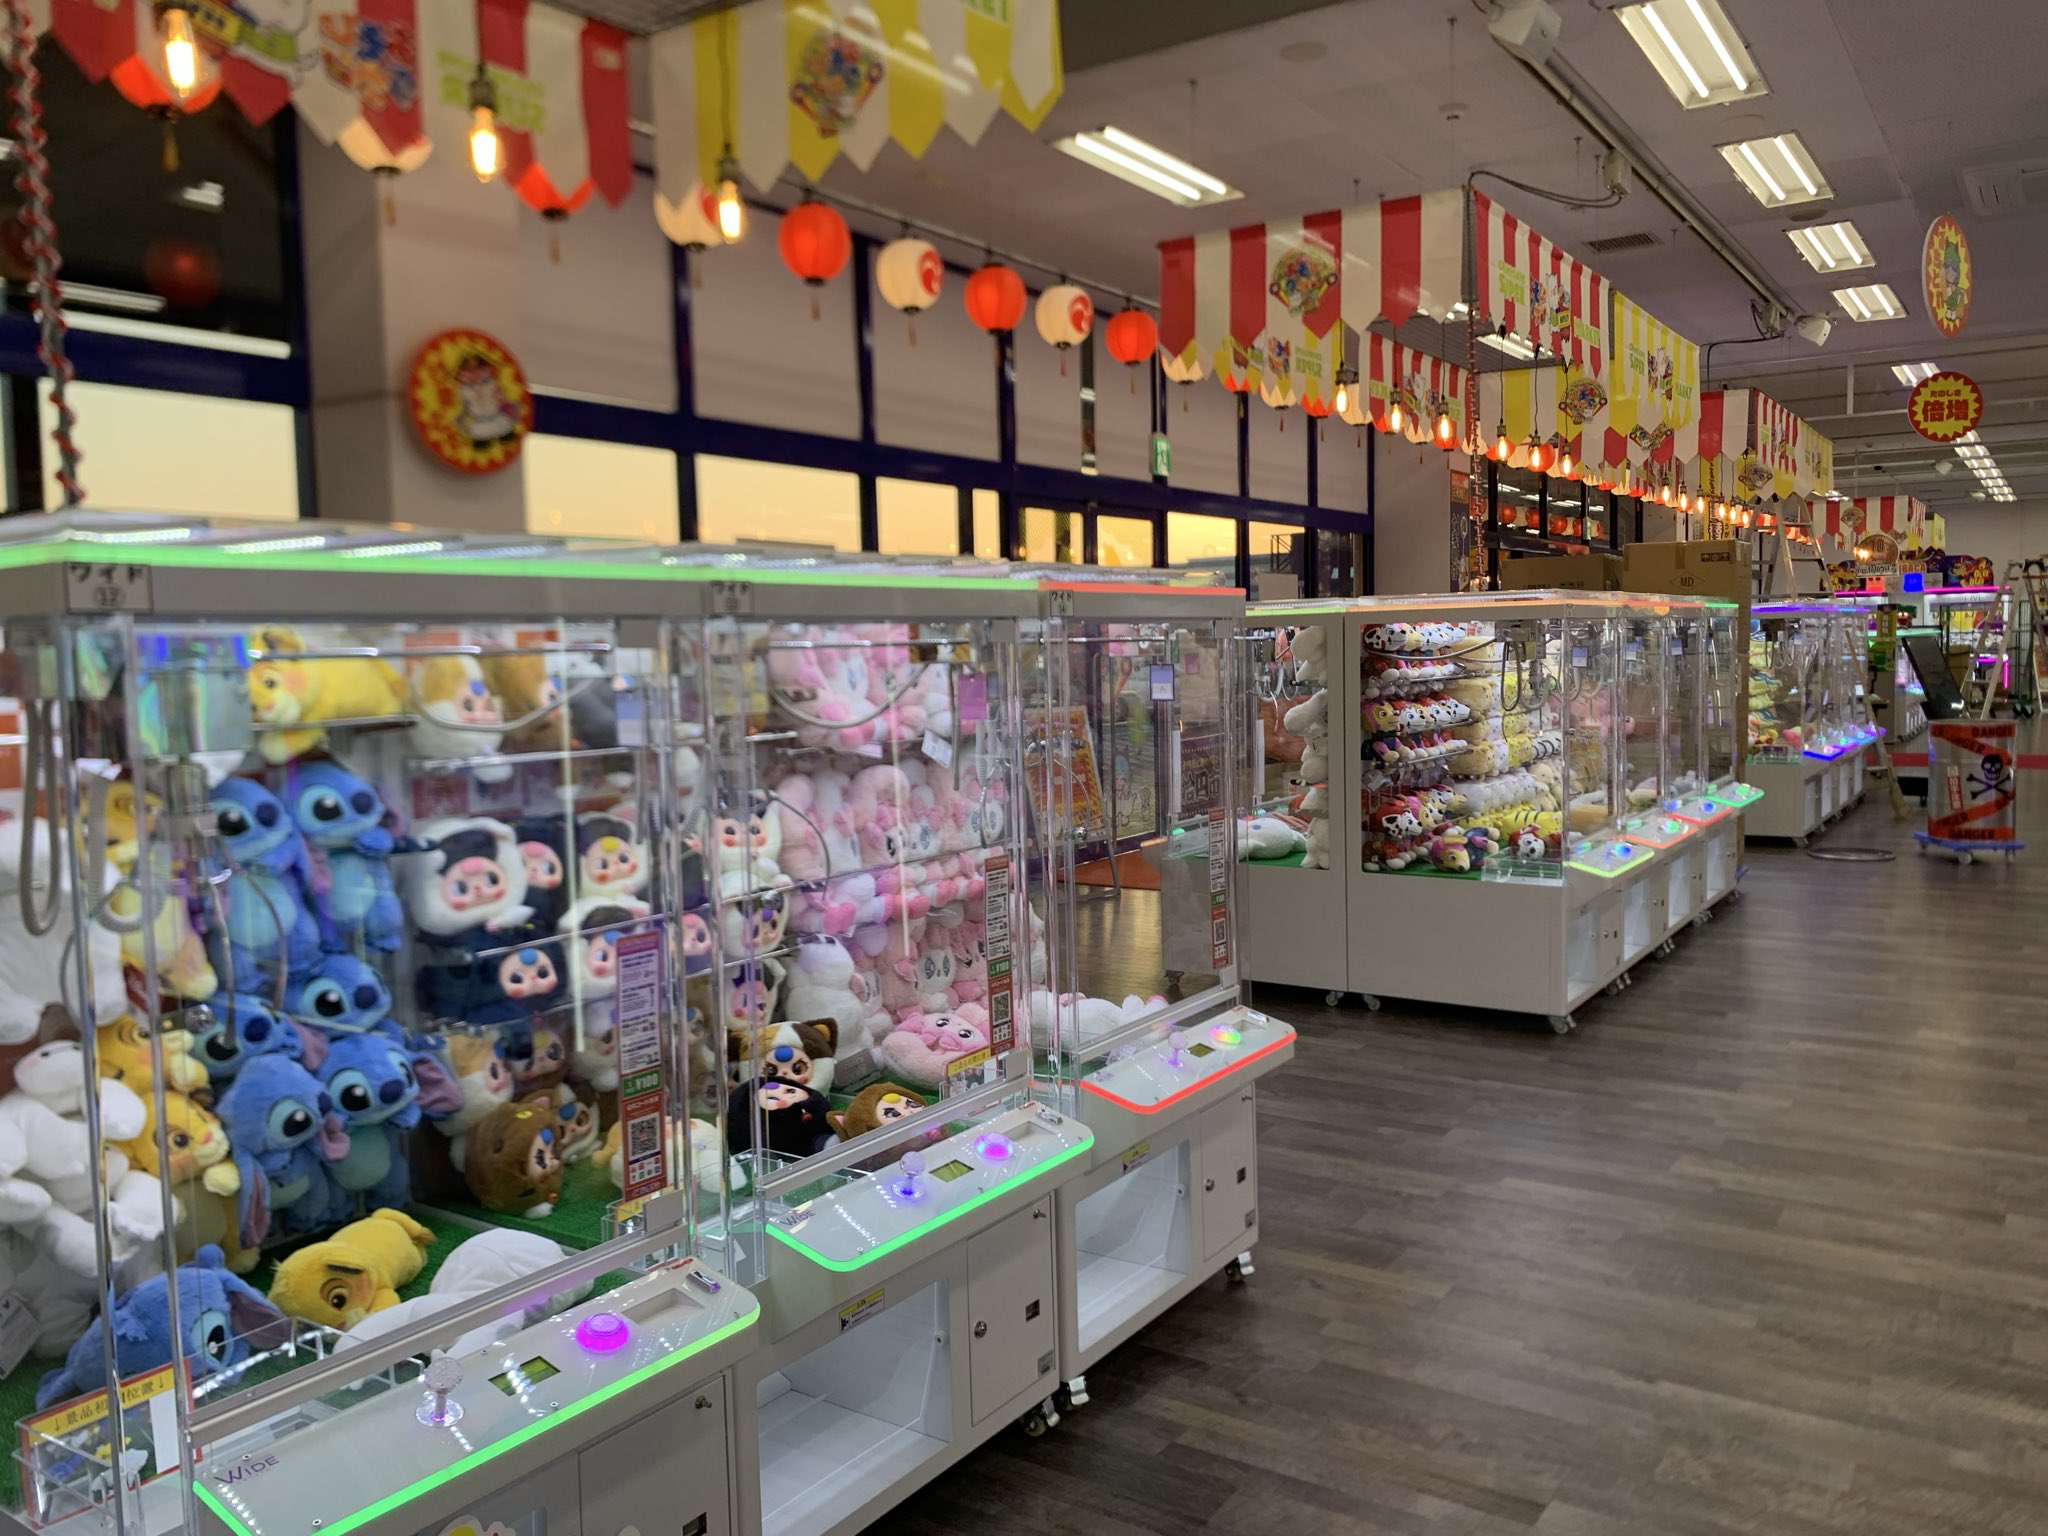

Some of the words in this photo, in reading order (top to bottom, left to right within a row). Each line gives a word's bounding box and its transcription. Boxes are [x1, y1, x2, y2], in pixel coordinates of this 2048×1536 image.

[1922, 399, 1969, 423] 倍増
[1680, 577, 1694, 587] MD
[1971, 726, 2013, 738] DANGER
[1948, 829, 1996, 840] DANGER
[778, 1210, 816, 1226] WIDE
[66, 1381, 153, 1425] 景品初位置
[213, 1455, 280, 1484] WIDE
